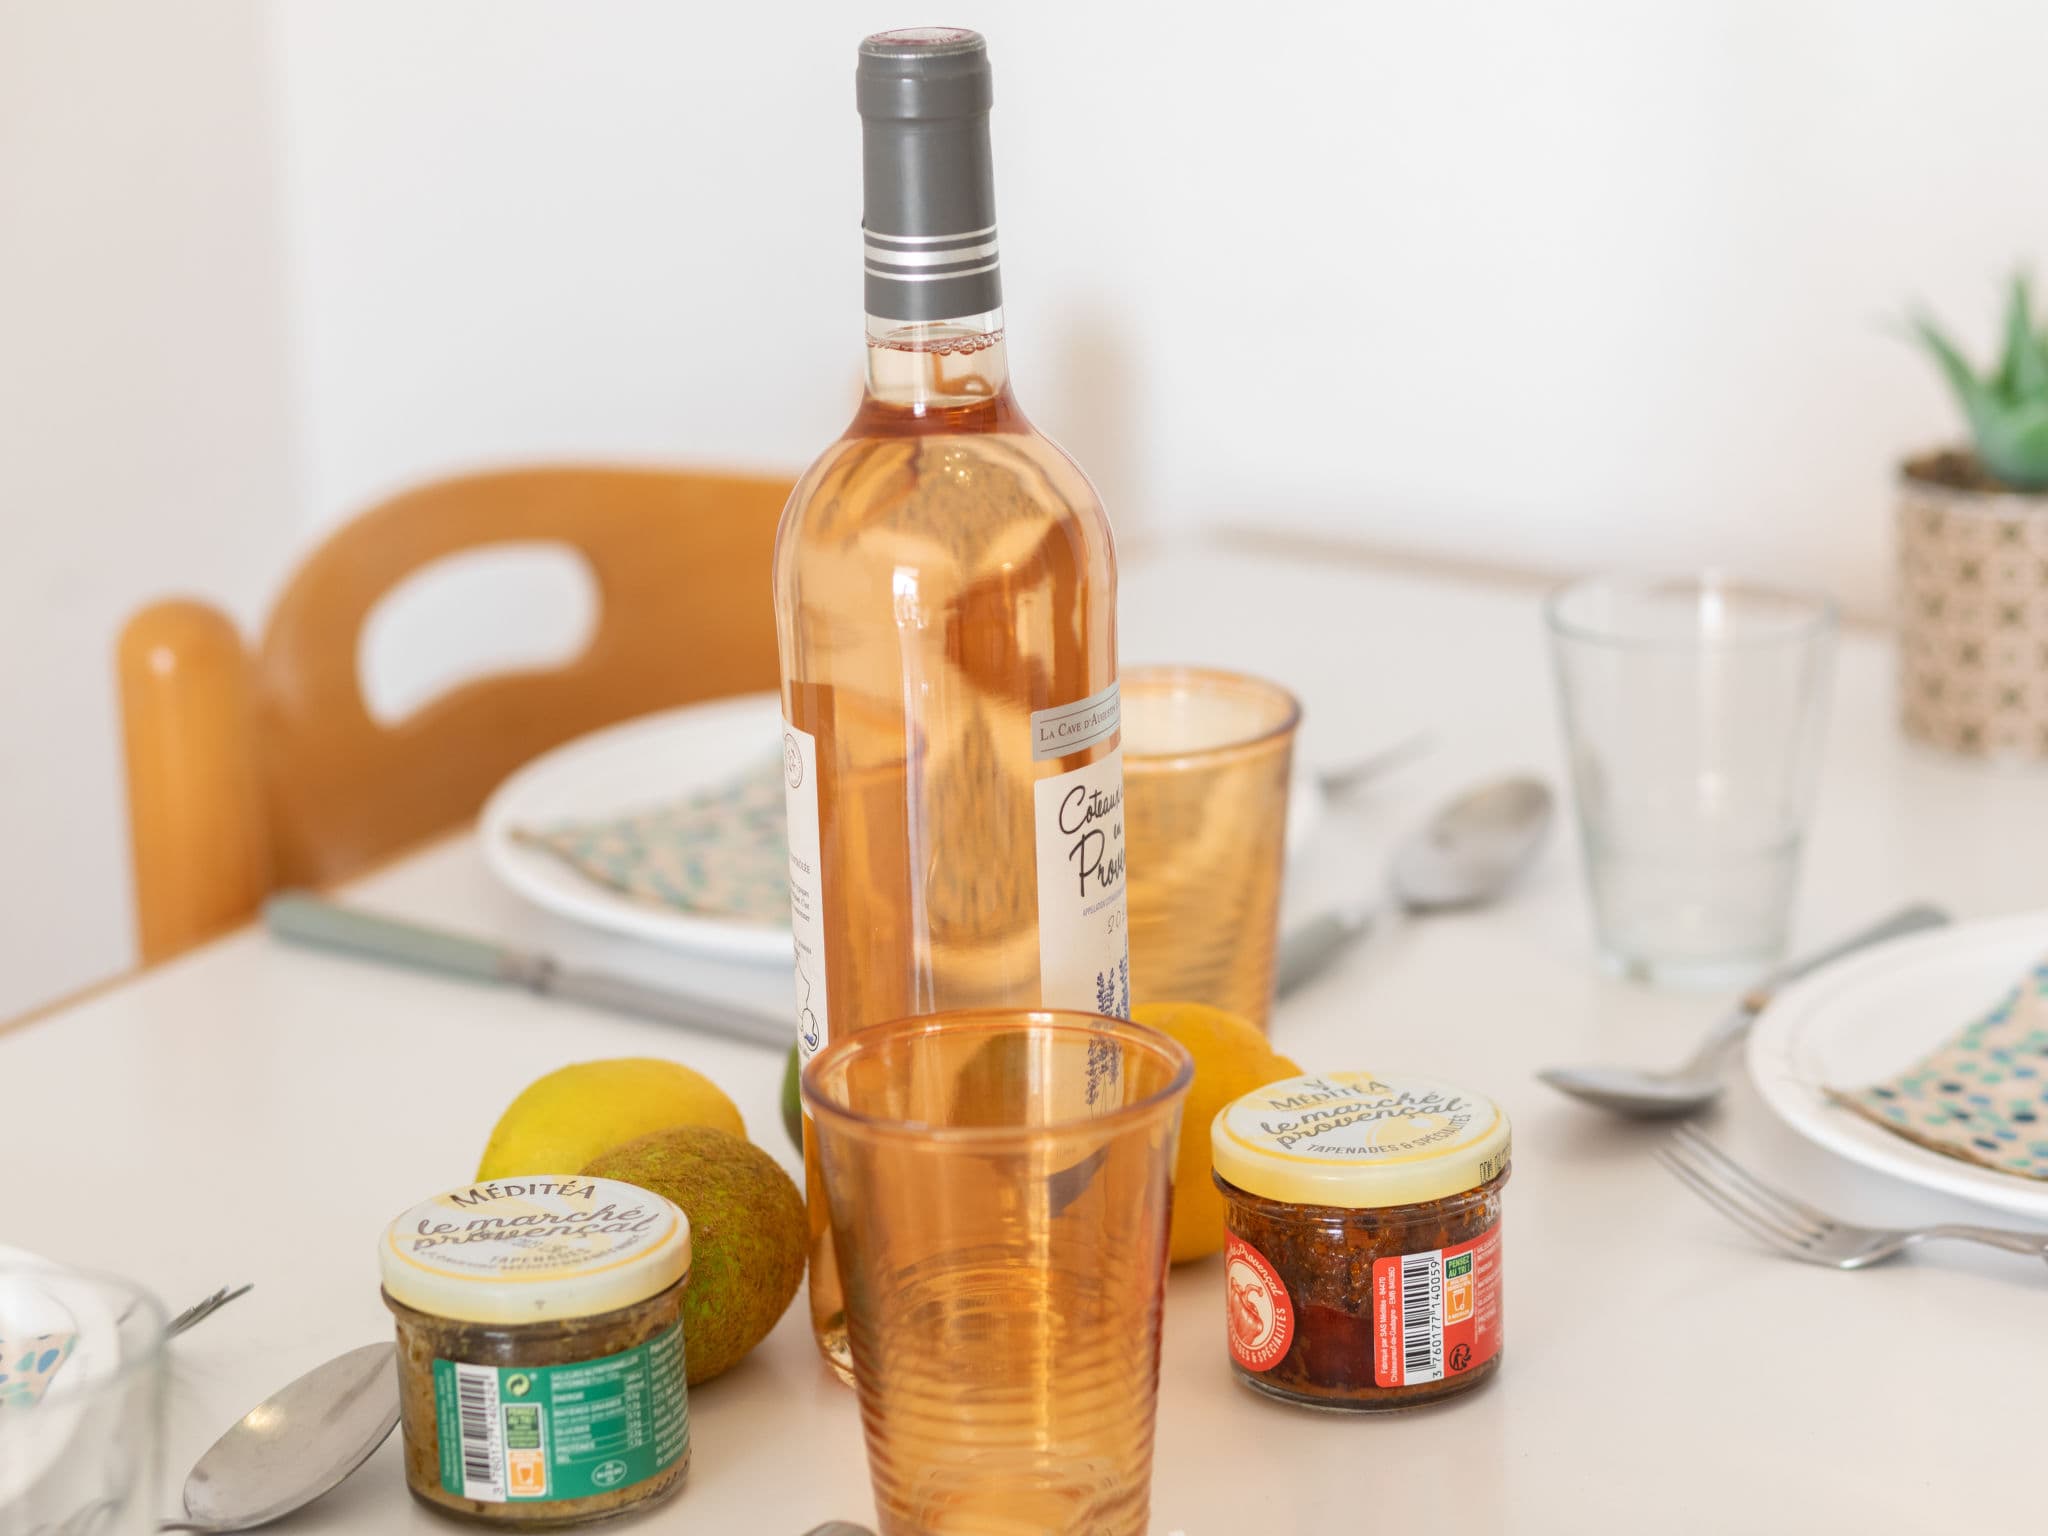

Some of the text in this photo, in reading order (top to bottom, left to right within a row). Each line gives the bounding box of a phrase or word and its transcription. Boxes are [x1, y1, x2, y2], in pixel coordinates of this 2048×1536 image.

[1059, 785, 1121, 834] Coteaux
[1260, 1090, 1445, 1135] le marché
[1276, 1097, 1463, 1150] provençal
[1306, 1144, 1399, 1155] TAPENADES
[449, 1179, 597, 1208] MÉDITÉA
[412, 1213, 659, 1251] provençal
[417, 1203, 646, 1236] le marché
[1448, 1255, 1470, 1269] PENSEZ
[1448, 1268, 1457, 1278] AU
[1430, 1260, 1442, 1379] 3 760177 140059
